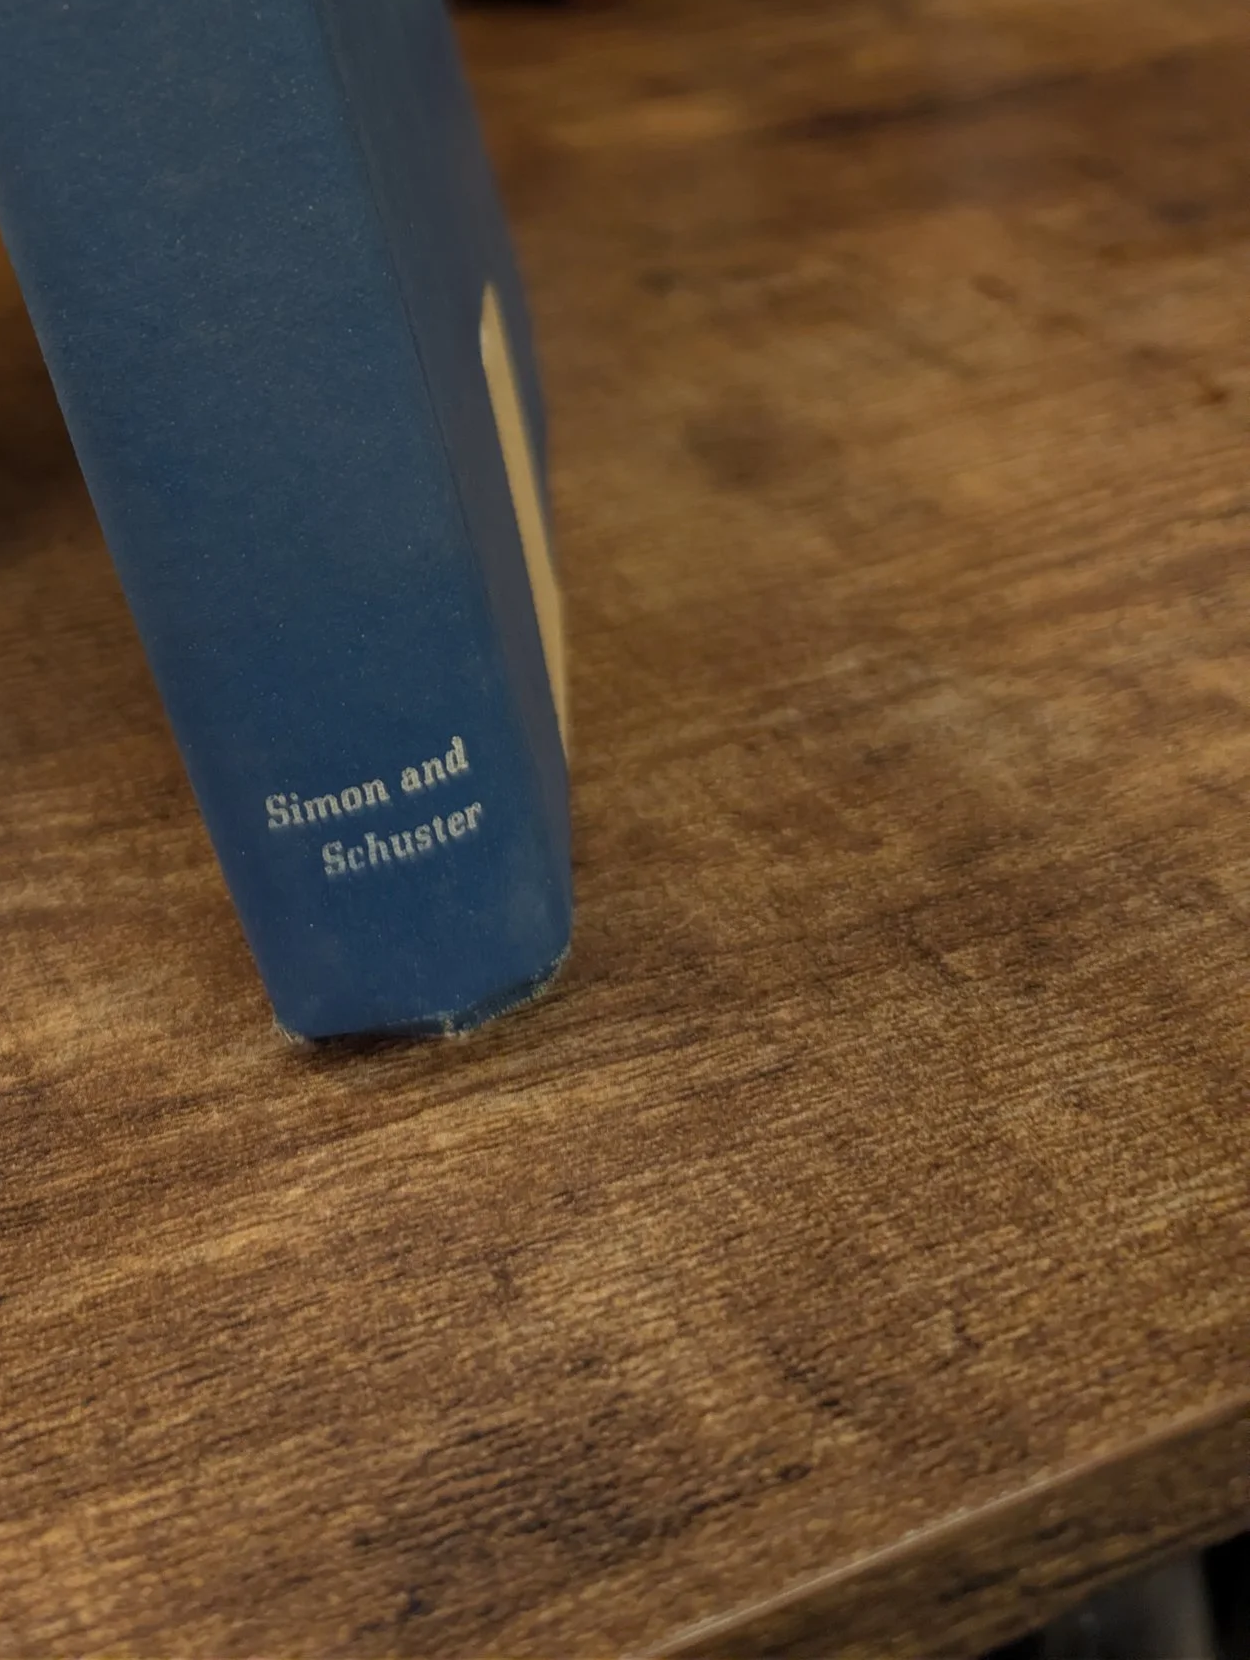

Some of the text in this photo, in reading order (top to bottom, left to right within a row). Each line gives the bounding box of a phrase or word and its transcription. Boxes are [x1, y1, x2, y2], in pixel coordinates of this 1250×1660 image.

[264, 734, 471, 831] Simon and
[321, 801, 484, 877] Schuster
